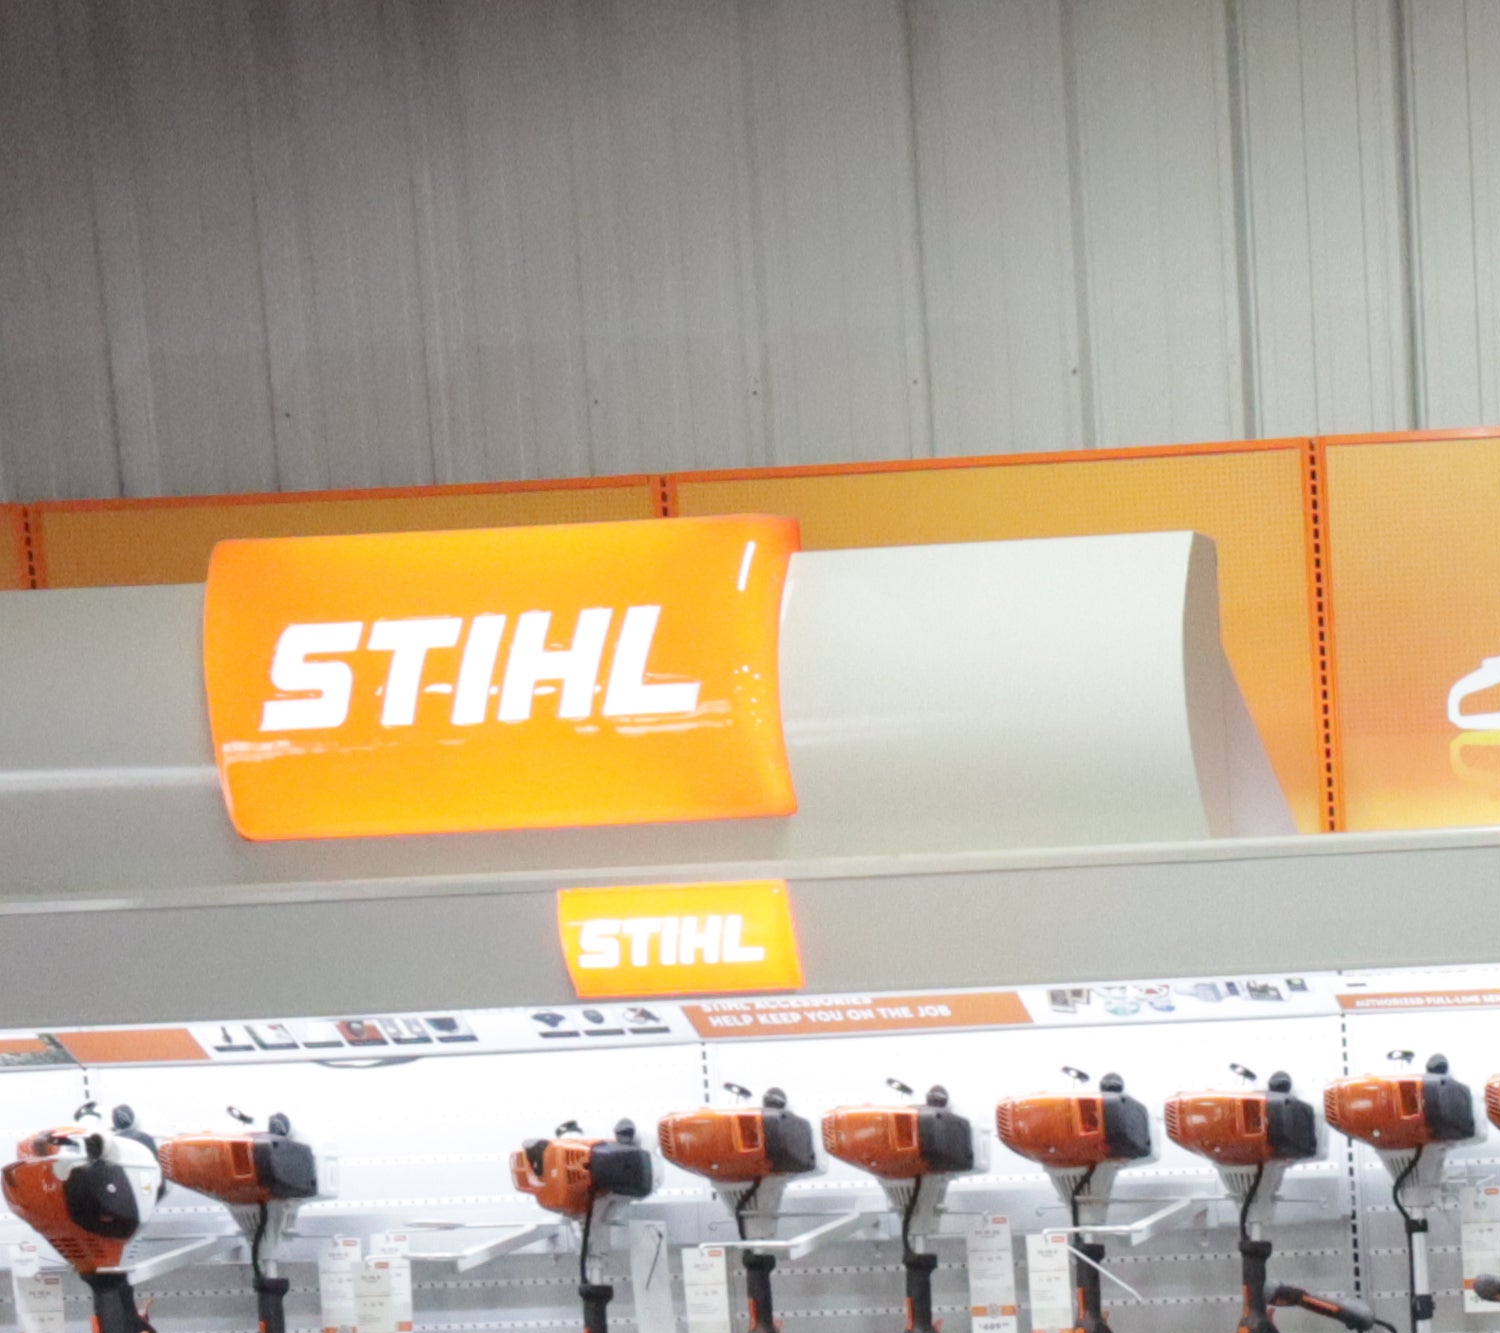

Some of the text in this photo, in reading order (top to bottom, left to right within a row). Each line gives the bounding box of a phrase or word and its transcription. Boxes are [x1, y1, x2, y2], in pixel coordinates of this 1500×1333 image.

[259, 605, 701, 731] STIHL
[578, 914, 766, 969] STIHL
[709, 1004, 952, 1027] HELP KEEP YOU ON THE JOB
